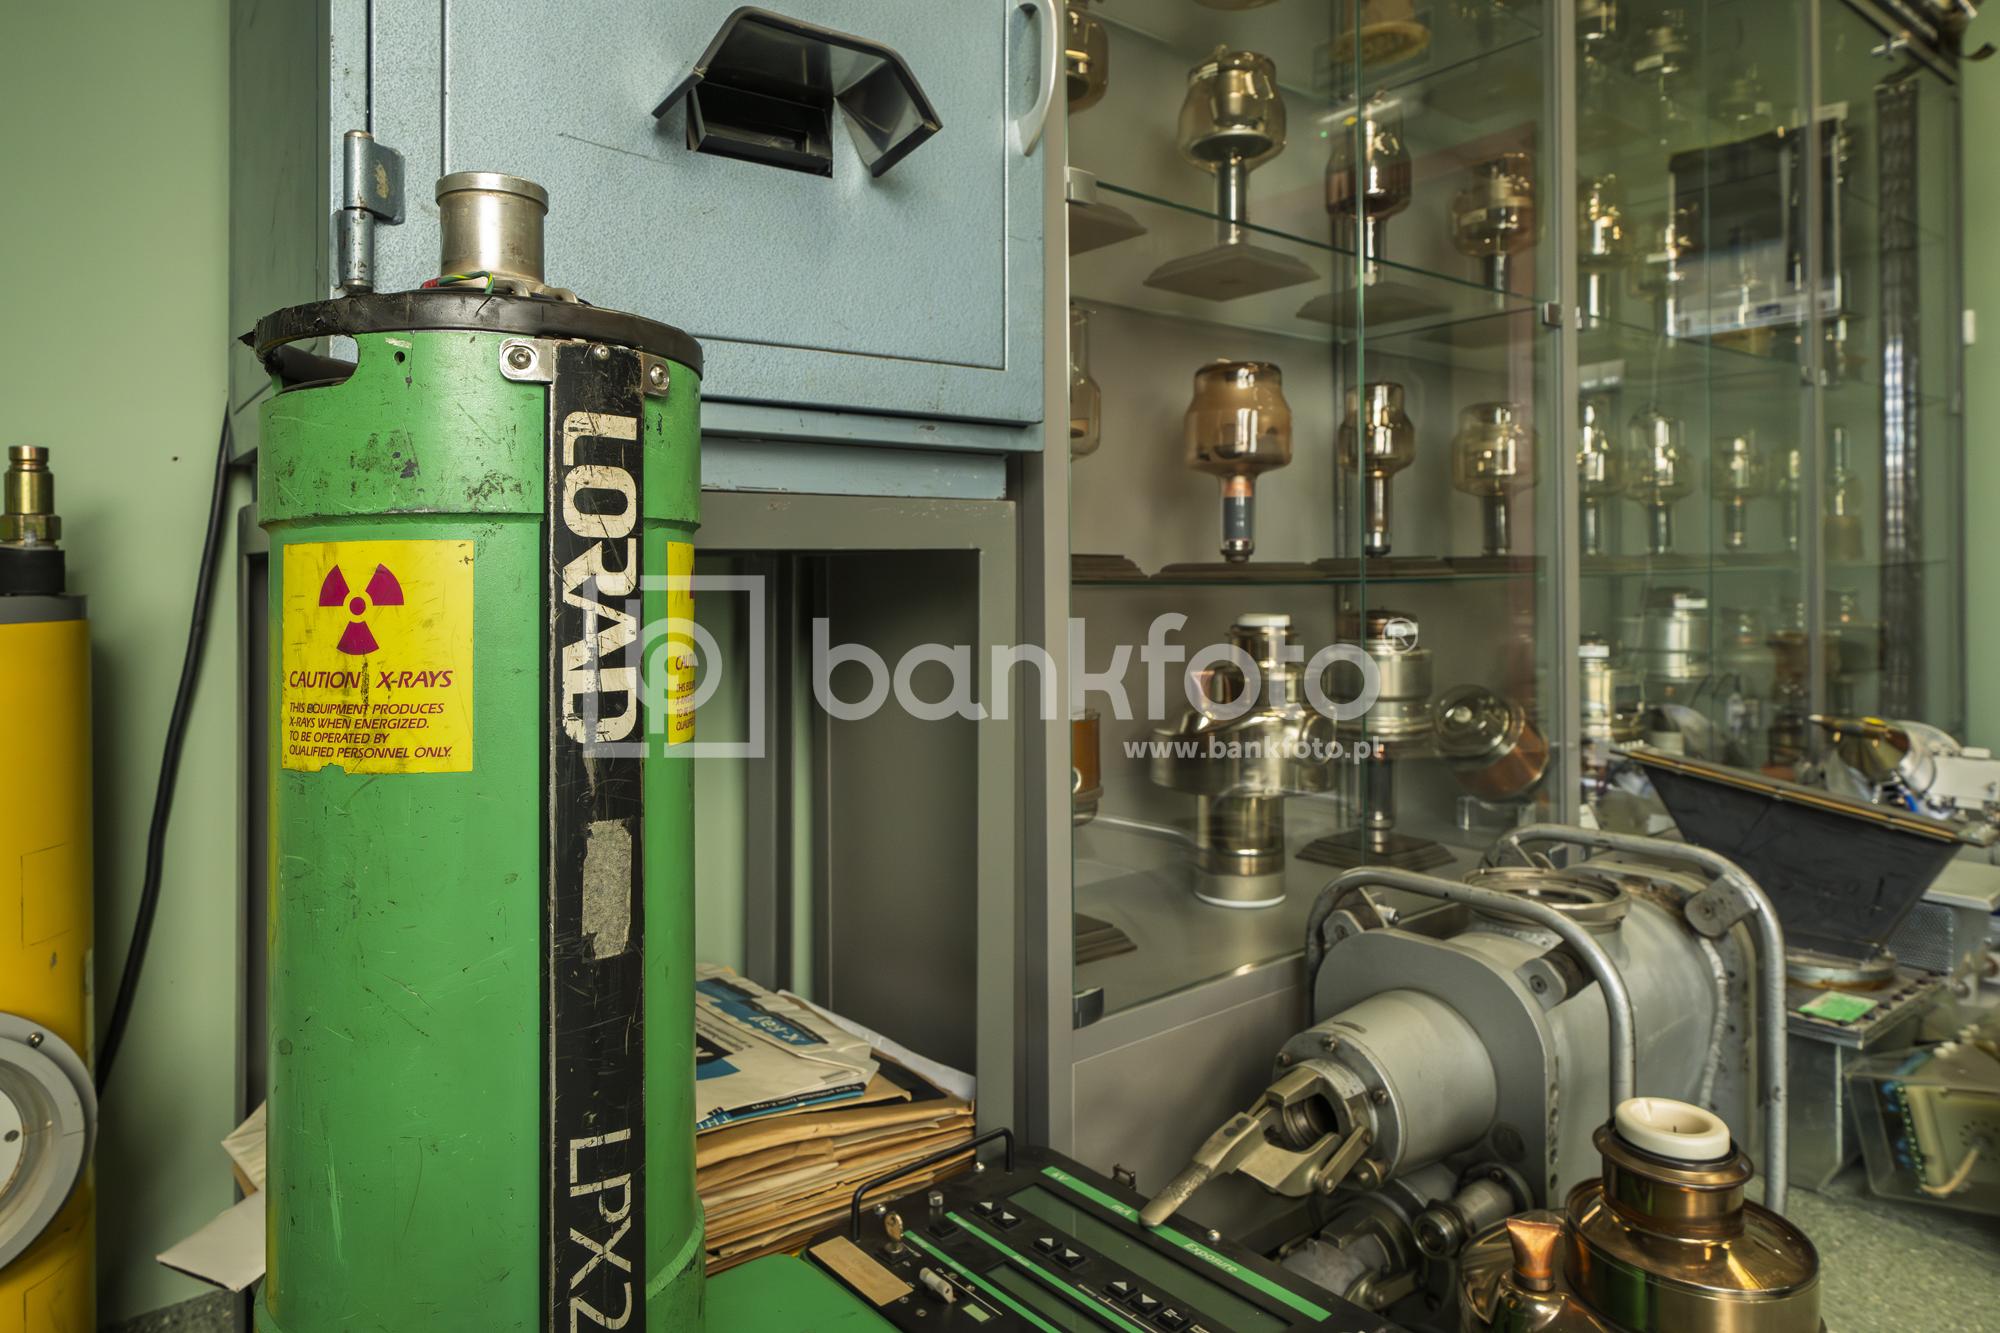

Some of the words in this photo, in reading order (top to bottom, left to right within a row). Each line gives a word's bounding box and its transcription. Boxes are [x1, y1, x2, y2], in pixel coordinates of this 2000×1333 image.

[562, 411, 637, 744] LORAD
[289, 670, 361, 689] CAUTION
[375, 670, 453, 689] X-RAYS
[289, 702, 305, 713] THIS
[307, 703, 369, 715] EQUIPMENT
[372, 703, 445, 715] PRODUCES
[289, 716, 315, 728] X-RAYS
[318, 718, 351, 729] WHEN
[354, 718, 429, 729] ENERGIZED.
[289, 730, 299, 741] TO
[301, 731, 312, 742] BE
[313, 732, 370, 744] OPERATED
[374, 733, 390, 744] BY
[289, 744, 334, 758] QUALIFIED
[336, 747, 409, 759] PERSONNEL
[414, 746, 452, 758] ONLY.
[1183, 1242, 1238, 1274] Exposure
